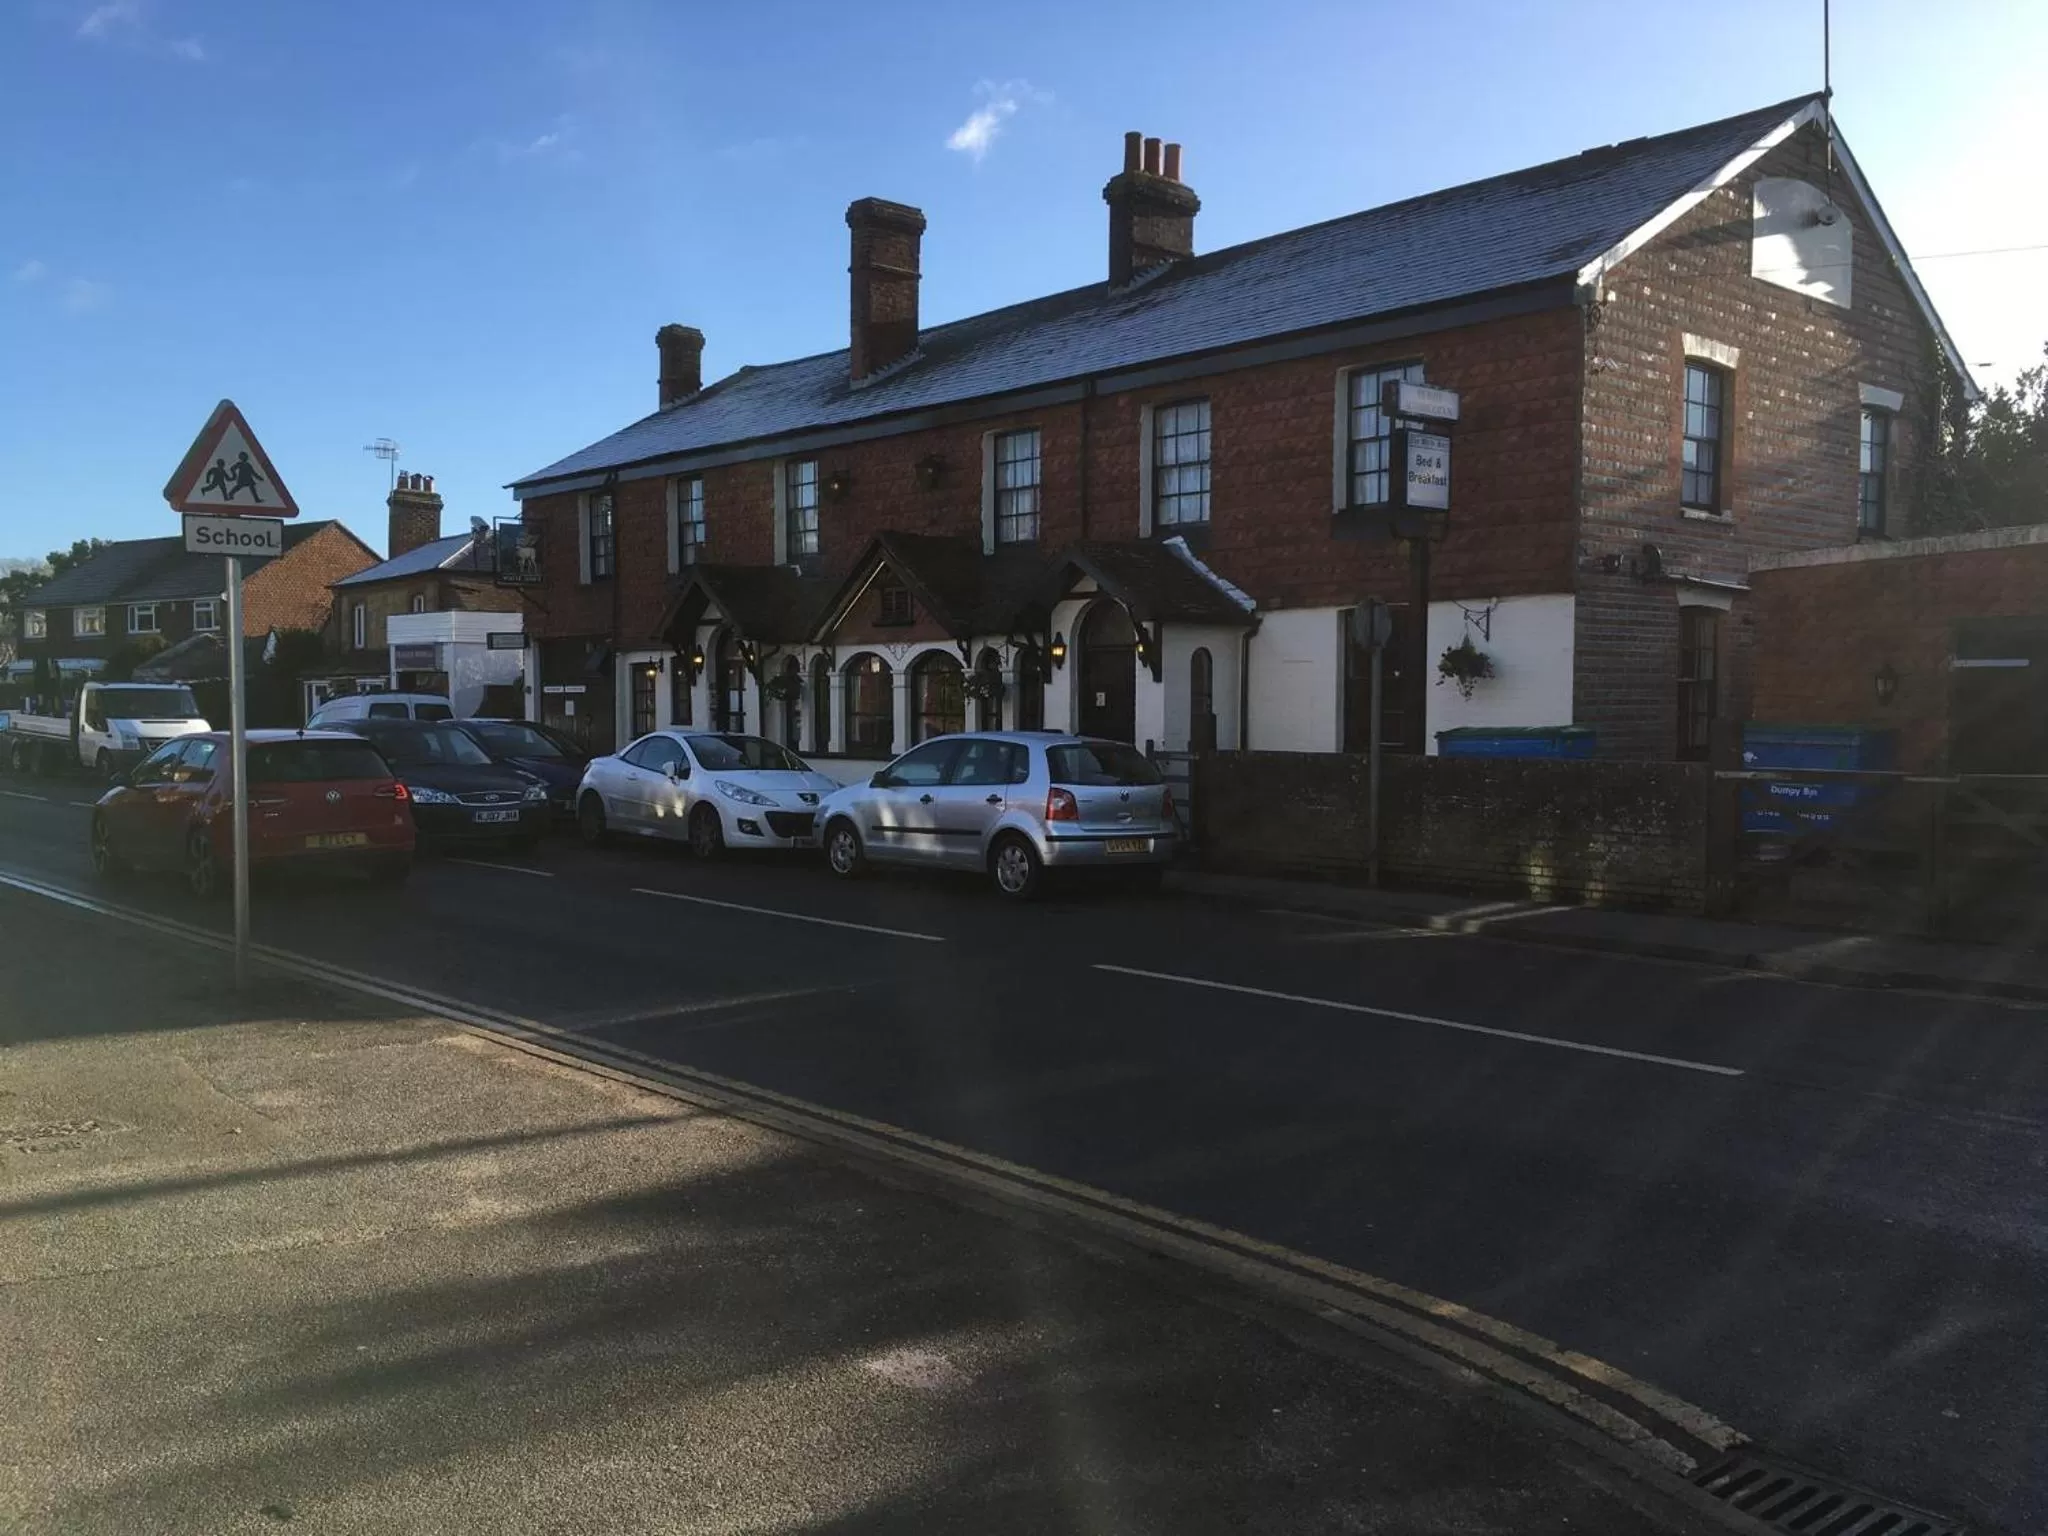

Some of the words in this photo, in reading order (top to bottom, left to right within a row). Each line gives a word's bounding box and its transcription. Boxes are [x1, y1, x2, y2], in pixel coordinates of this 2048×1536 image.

[1416, 454, 1432, 468] Bed
[1436, 457, 1442, 469] &
[1408, 471, 1447, 486] Breakfast
[196, 526, 275, 548] School
[1771, 786, 1801, 797] Dumpy
